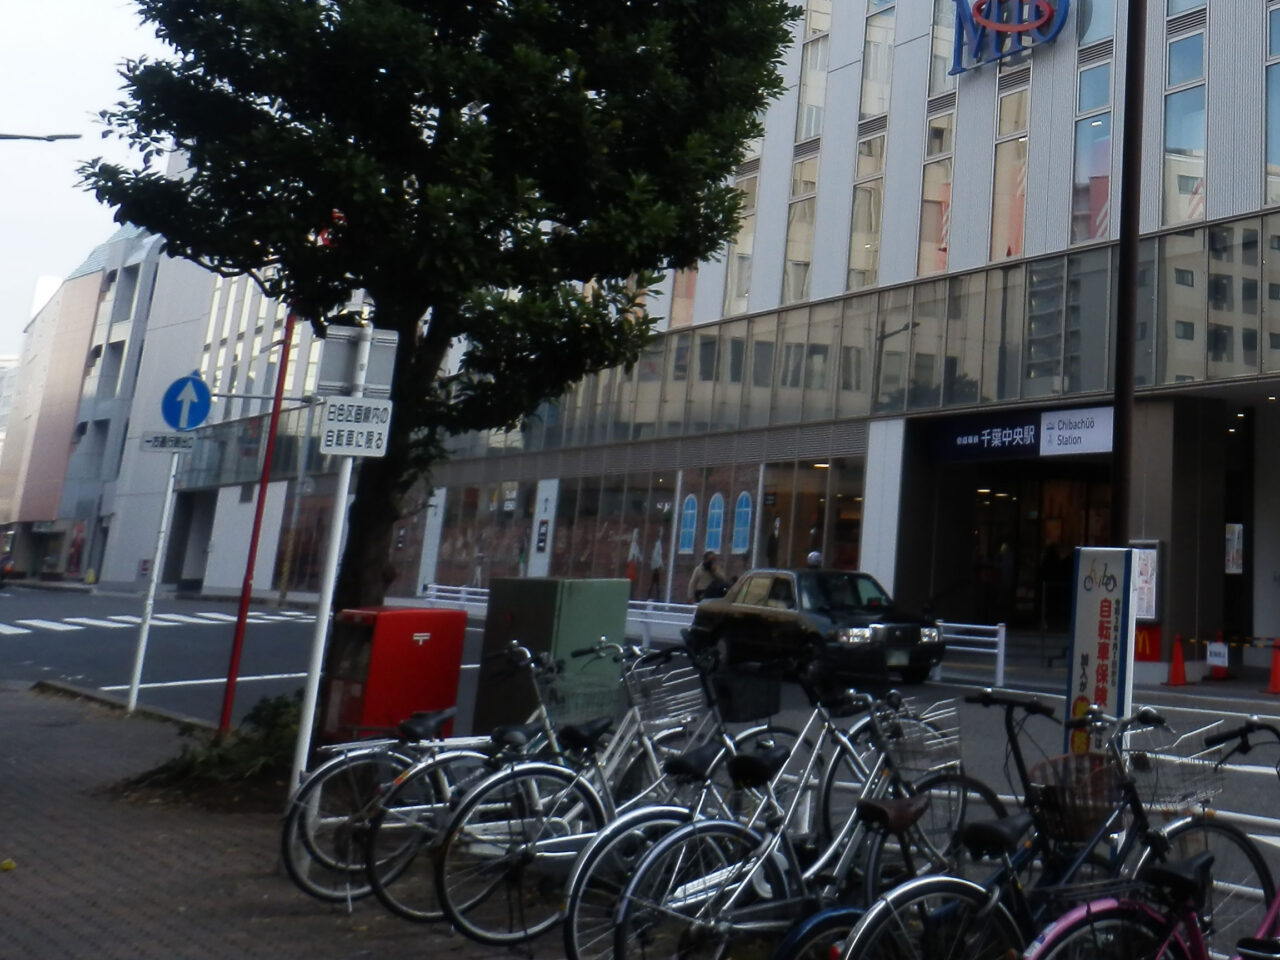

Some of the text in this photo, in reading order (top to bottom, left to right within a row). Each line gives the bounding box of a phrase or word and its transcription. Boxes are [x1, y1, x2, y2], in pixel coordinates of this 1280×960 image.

[980, 425, 1035, 448] 千葉中央駅
[1057, 435, 1082, 446] Station
